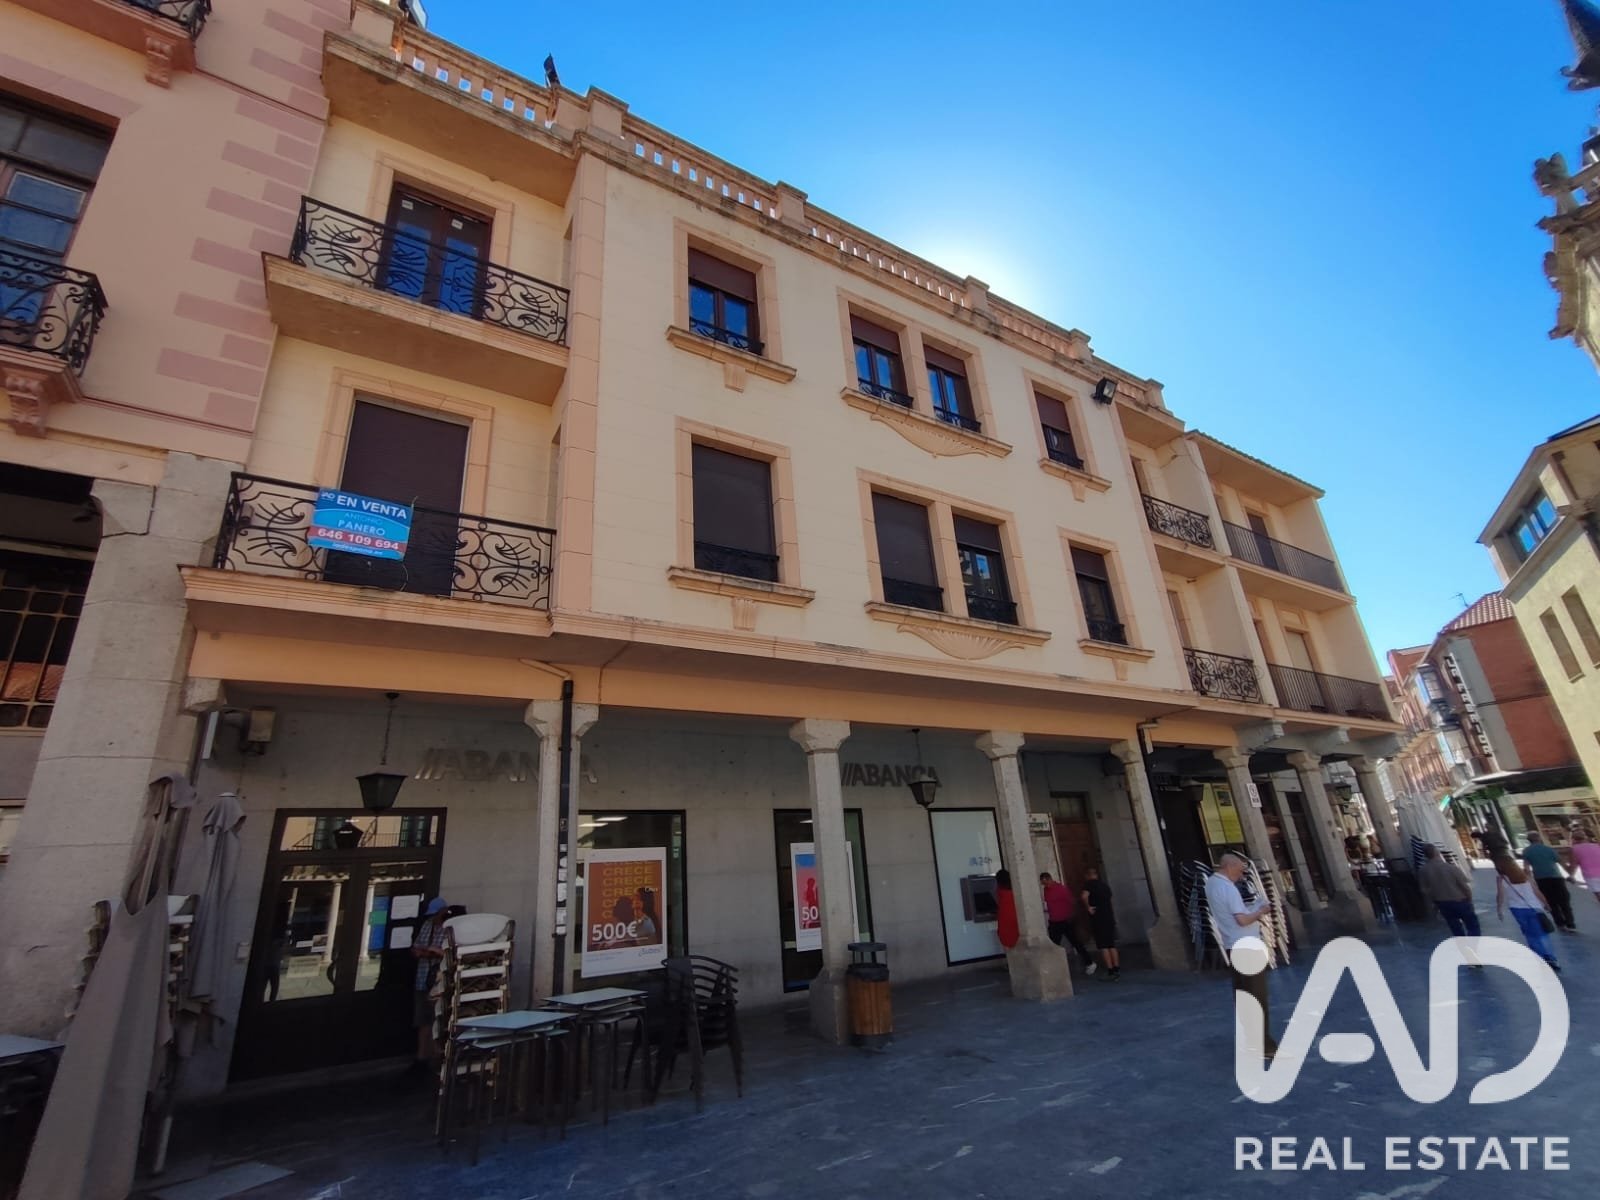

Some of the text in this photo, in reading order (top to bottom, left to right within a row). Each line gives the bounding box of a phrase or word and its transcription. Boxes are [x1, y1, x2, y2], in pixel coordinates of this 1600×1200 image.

[336, 495, 358, 508] EN
[361, 500, 408, 519] VENTA
[344, 512, 383, 525] ANTONIO
[337, 520, 386, 536] PANERO
[317, 528, 399, 551] 646 109 694
[414, 747, 598, 784] ABANA
[602, 866, 654, 877] CRECE
[602, 876, 654, 888] CRECE
